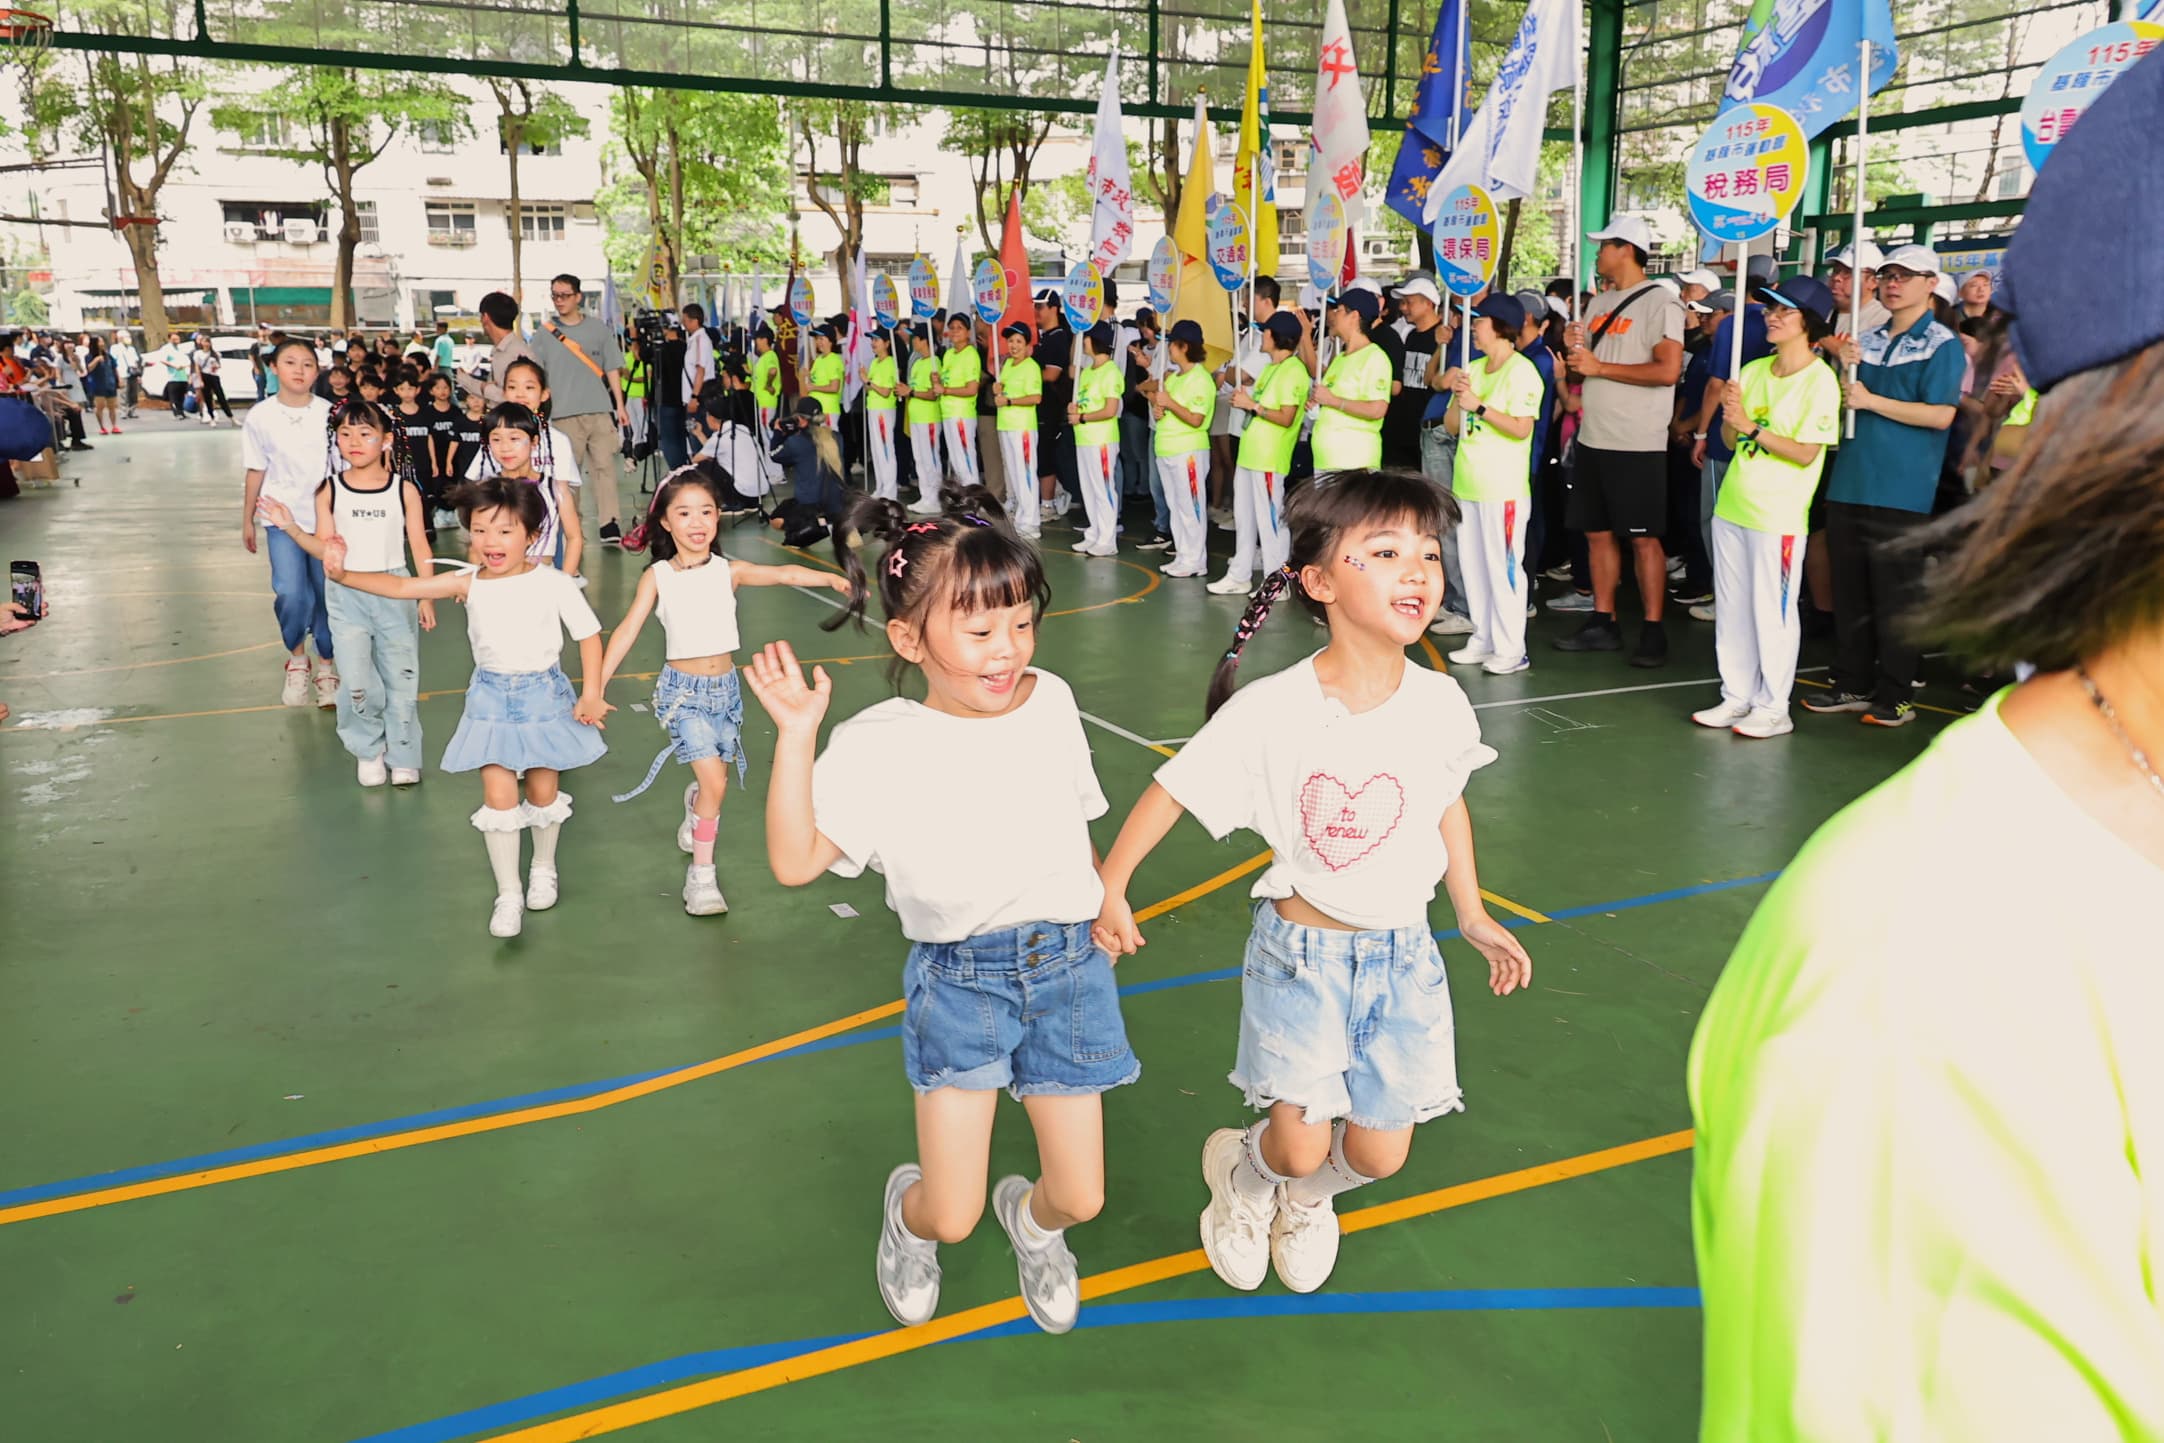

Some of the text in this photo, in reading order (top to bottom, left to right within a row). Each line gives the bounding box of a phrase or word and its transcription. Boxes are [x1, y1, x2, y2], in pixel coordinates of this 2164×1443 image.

[1726, 117, 1771, 140] 115年
[2037, 107, 2087, 142] 台電
[1704, 164, 1789, 200] 稅務局
[1216, 244, 1246, 264] 交通處
[1443, 237, 1489, 260] 環保局
[1341, 806, 1356, 822] to
